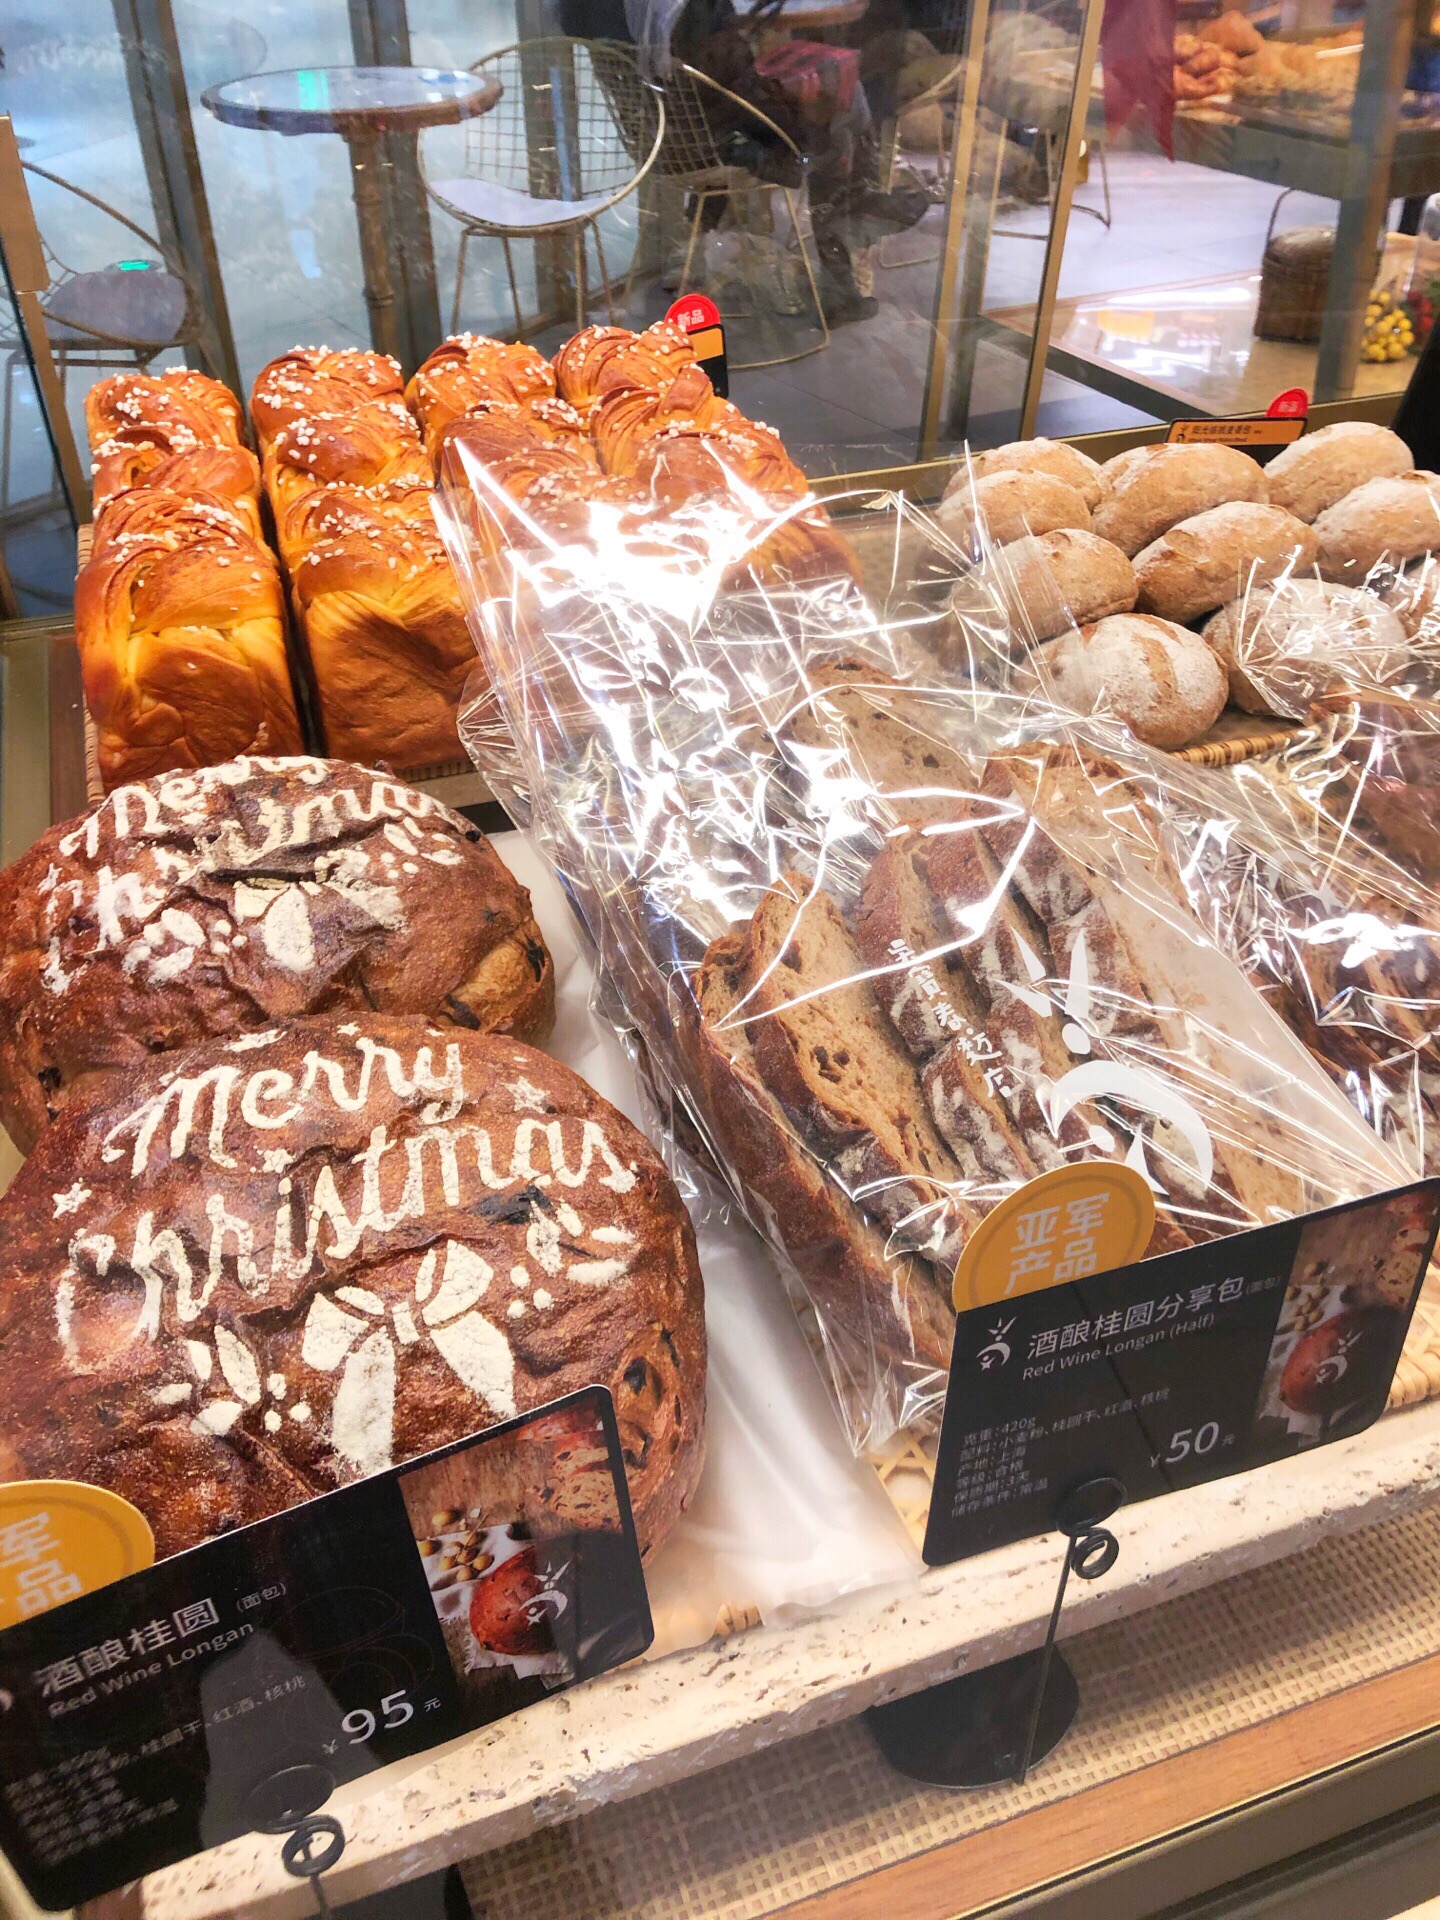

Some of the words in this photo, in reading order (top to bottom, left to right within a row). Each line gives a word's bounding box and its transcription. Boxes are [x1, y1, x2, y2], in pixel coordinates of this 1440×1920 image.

[102, 1037, 468, 1179] Merry
[55, 1116, 639, 1374] Christmas
[1013, 1191, 1110, 1253] 亚军
[1004, 1237, 1098, 1296] 产品
[1022, 1358, 1055, 1381] Red
[1060, 1347, 1102, 1370] Wine
[1105, 1331, 1166, 1357] Longan
[1169, 1311, 1216, 1340] (Half)
[1027, 1276, 1246, 1361] 酒酿桂圆分享包
[0, 1558, 83, 1615] 品
[33, 1596, 221, 1699] 酒酿桂圆
[48, 1685, 97, 1720] Red
[100, 1661, 163, 1696] Wine
[167, 1621, 255, 1668] Longan
